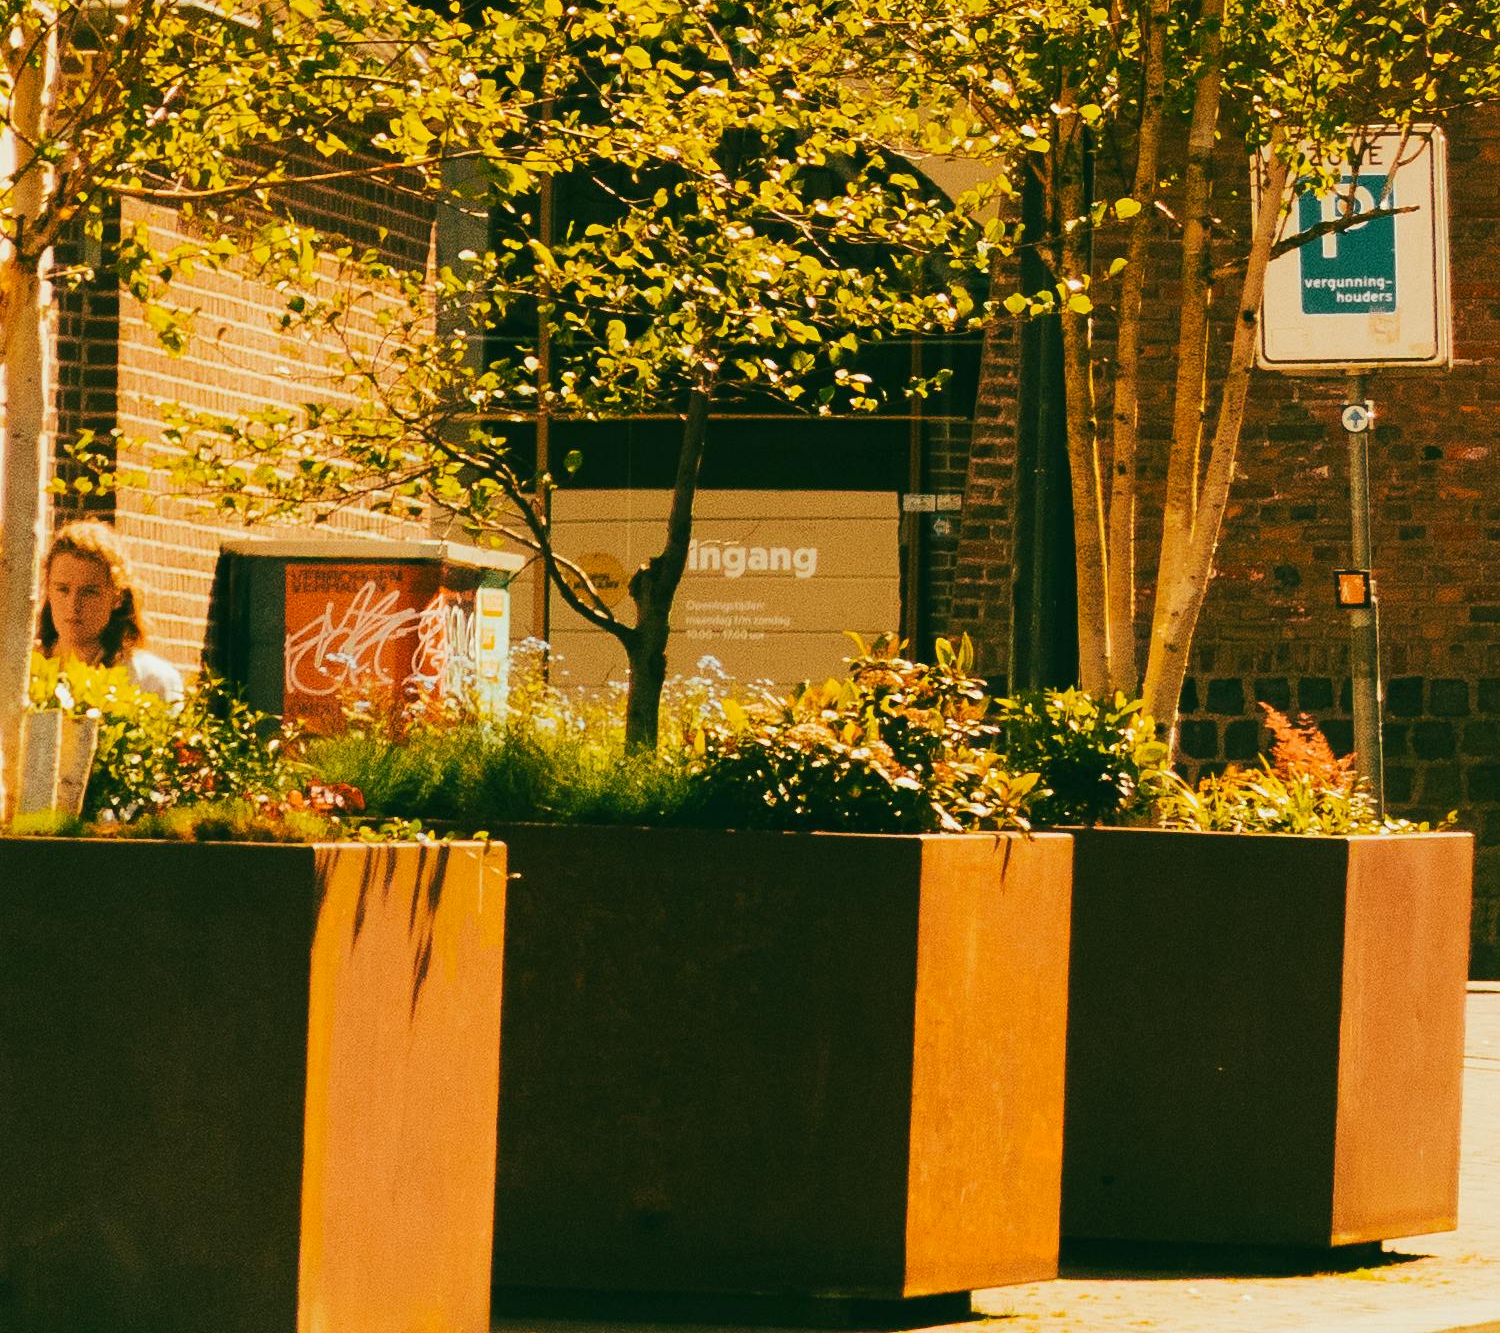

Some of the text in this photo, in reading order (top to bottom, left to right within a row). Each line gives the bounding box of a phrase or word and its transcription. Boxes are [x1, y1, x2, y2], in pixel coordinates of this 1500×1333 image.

[1307, 146, 1383, 166] ZOE
[1320, 183, 1375, 259] P
[1304, 276, 1393, 291] vergunning-
[1336, 291, 1393, 303] houders
